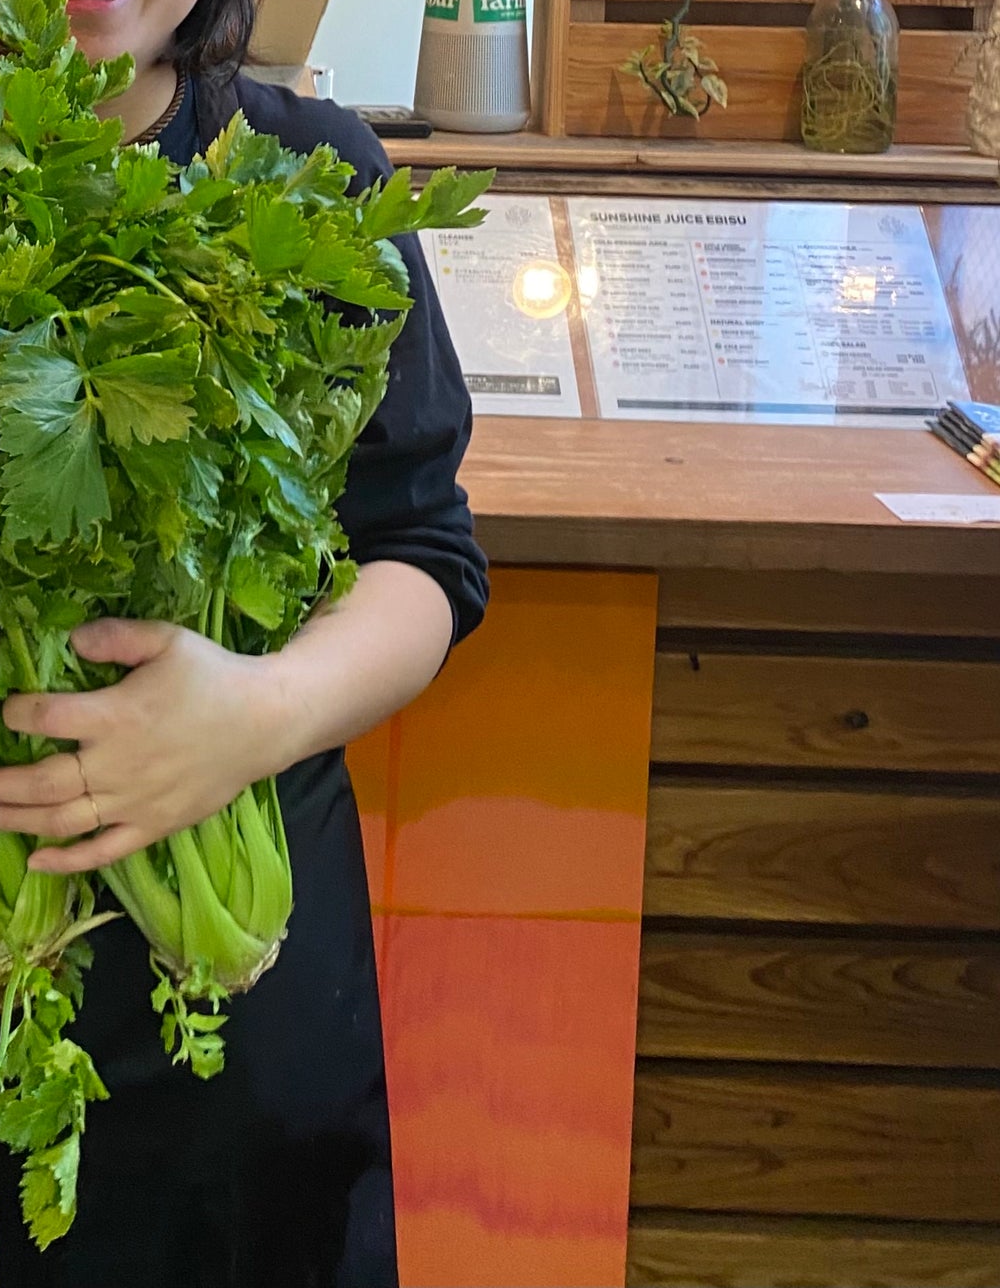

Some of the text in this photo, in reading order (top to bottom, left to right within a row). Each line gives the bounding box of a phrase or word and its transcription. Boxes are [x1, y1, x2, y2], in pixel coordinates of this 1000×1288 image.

[589, 212, 747, 225] SUNSHINE JUICE EBISU
